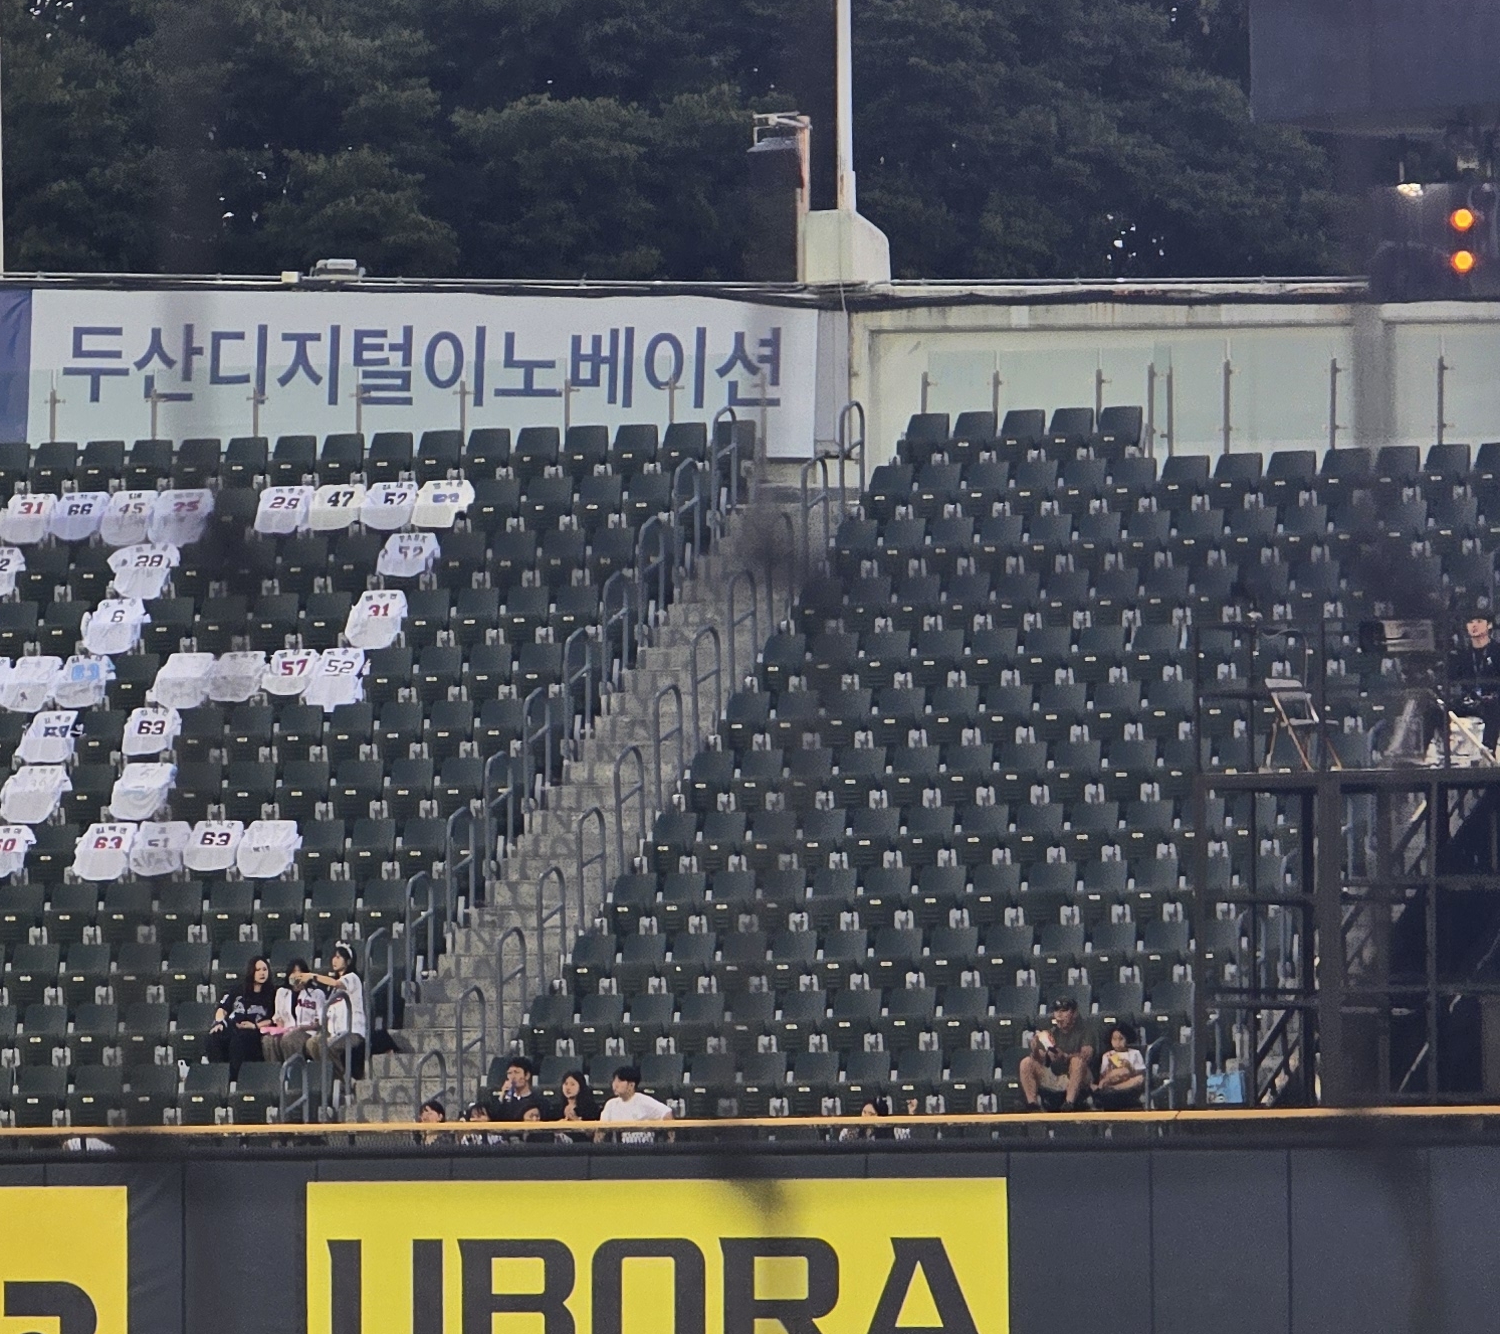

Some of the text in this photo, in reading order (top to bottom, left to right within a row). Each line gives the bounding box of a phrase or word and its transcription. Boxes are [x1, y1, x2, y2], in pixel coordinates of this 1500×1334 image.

[62, 323, 782, 409] 두산디지털이노베이션
[327, 491, 355, 507] 47
[18, 501, 43, 515] 31
[67, 503, 94, 516] 66
[119, 502, 145, 515] 45
[110, 610, 126, 623] 6
[367, 604, 390, 617] 31
[280, 658, 308, 676] 57
[324, 659, 355, 674] 52
[137, 720, 166, 735] 63
[200, 832, 231, 846] 63
